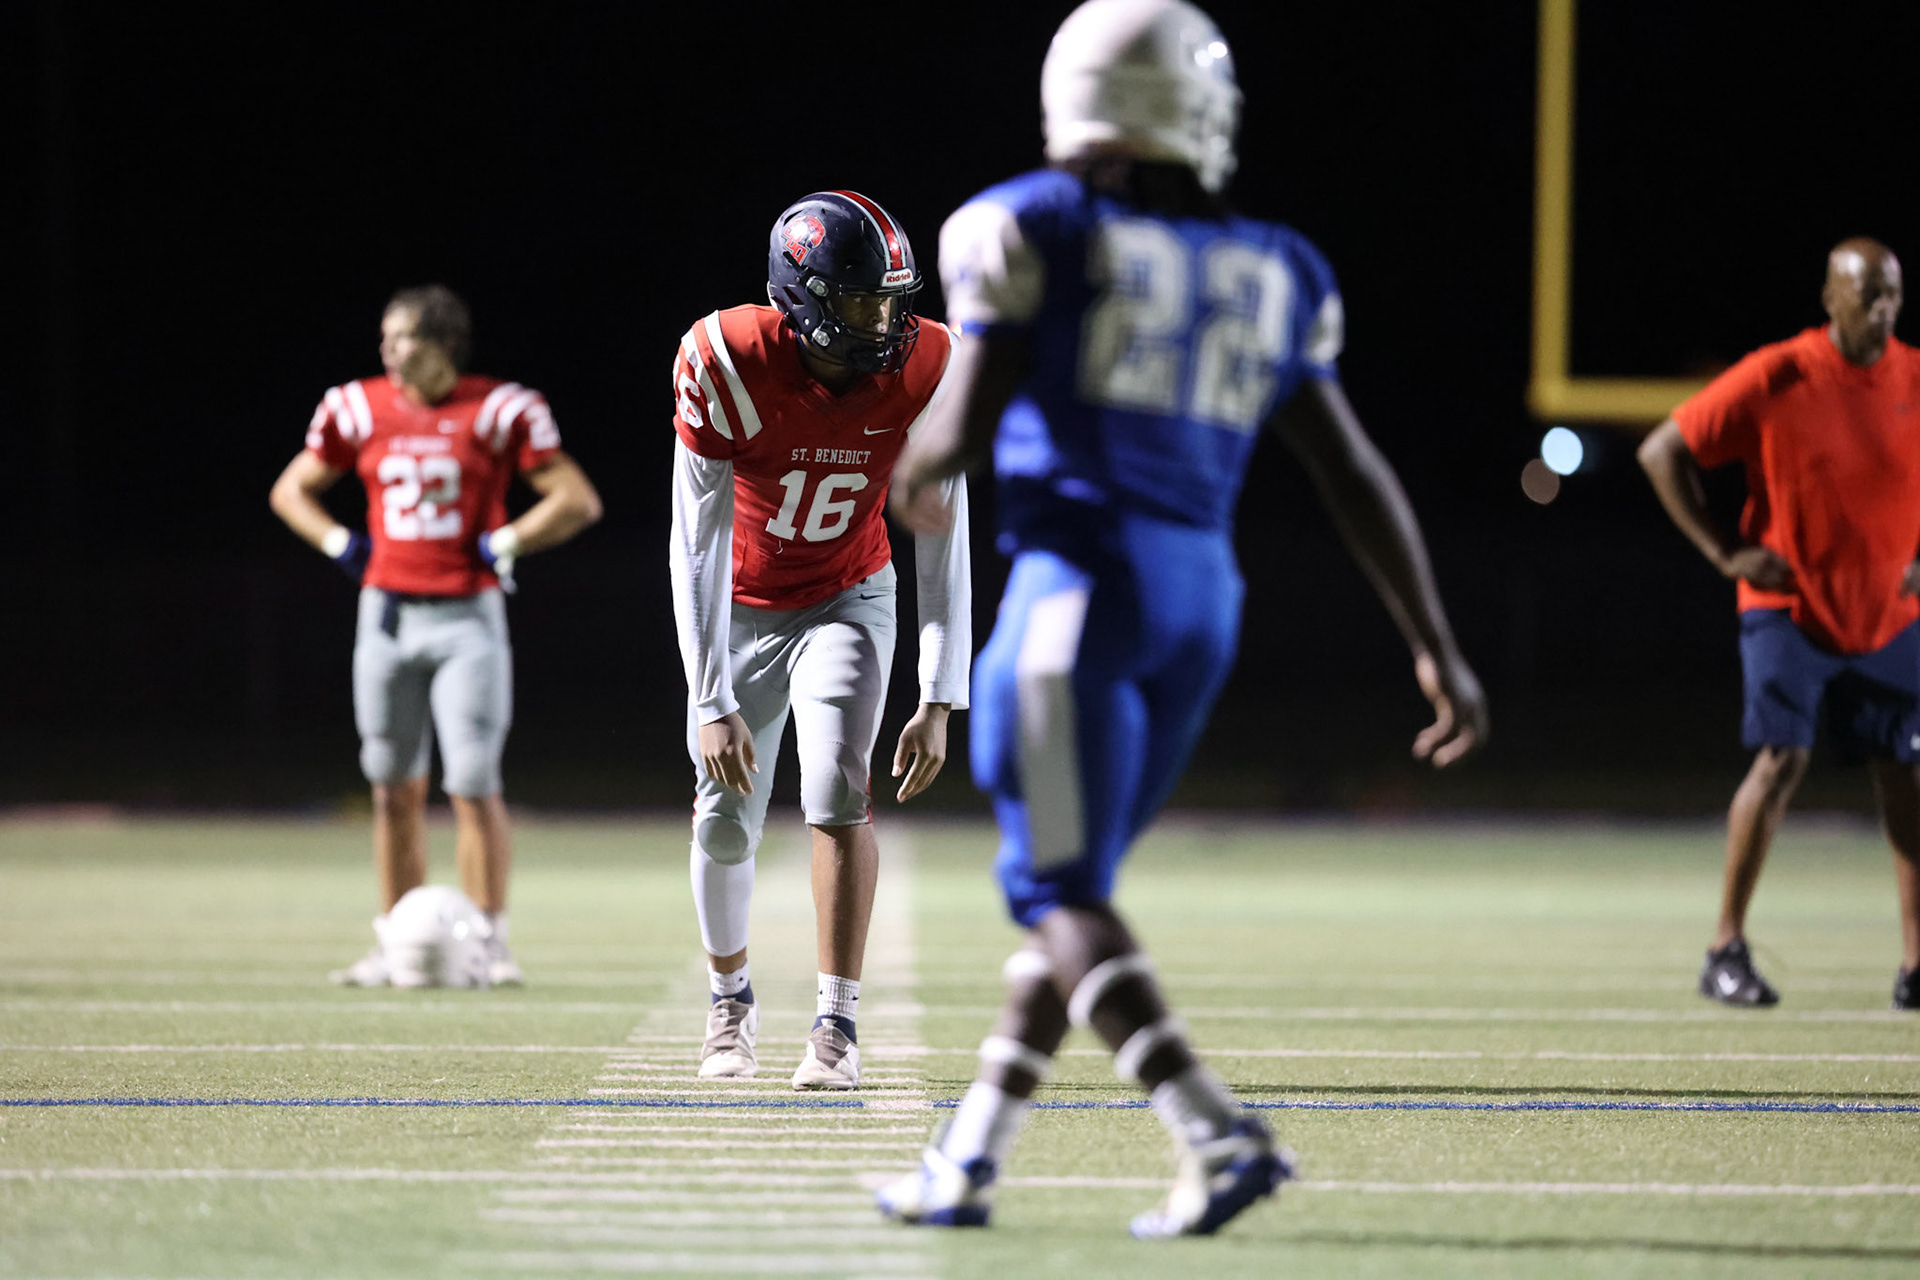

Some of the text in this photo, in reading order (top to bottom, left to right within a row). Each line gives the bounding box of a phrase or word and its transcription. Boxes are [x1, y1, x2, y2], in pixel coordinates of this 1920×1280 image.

[1080, 216, 1297, 434] 22
[791, 448, 871, 464] ST. BENEDICT
[377, 453, 462, 541] 22
[765, 469, 869, 542] 16
